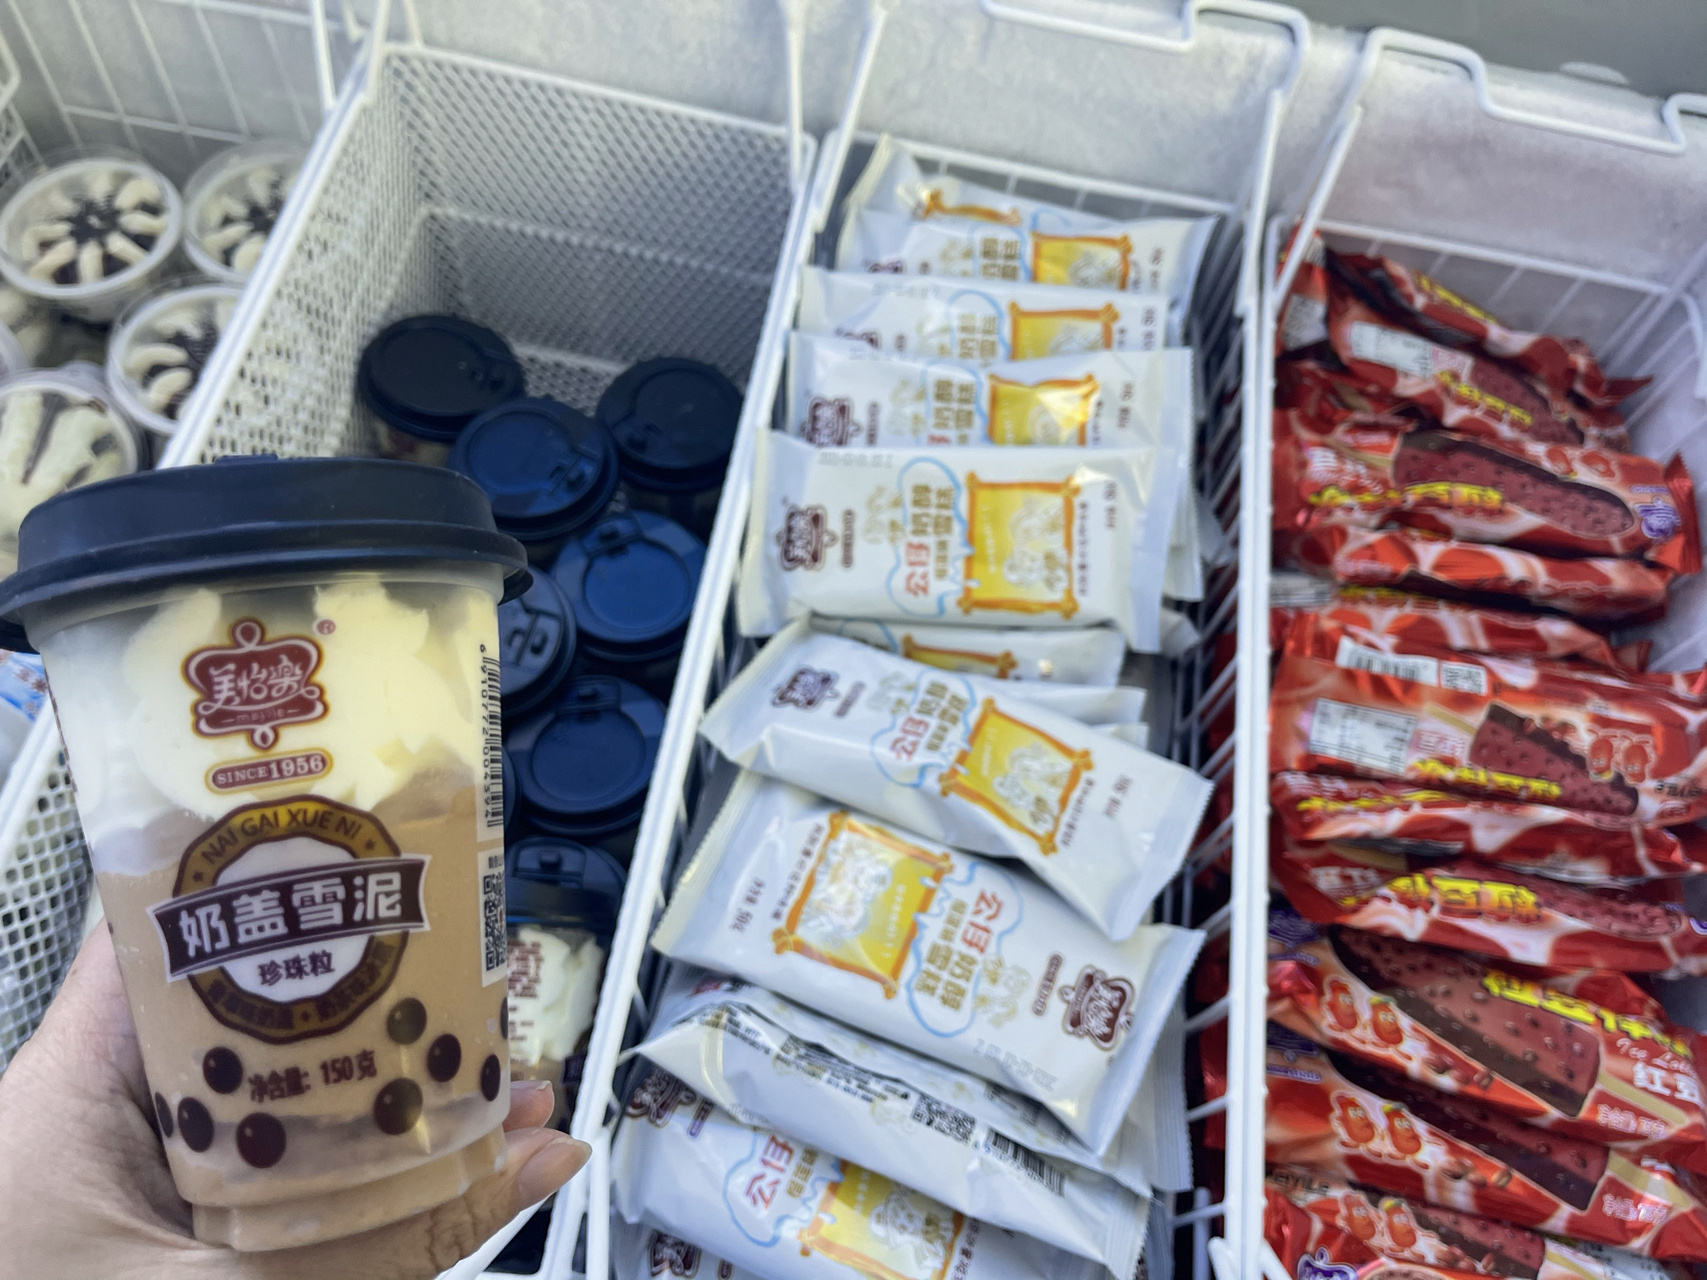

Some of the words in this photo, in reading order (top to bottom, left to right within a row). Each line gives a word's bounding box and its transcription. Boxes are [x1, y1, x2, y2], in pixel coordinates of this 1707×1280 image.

[201, 826, 239, 865] NAI
[241, 811, 279, 837] GAI
[287, 808, 333, 830] XUE
[335, 815, 362, 840] NI
[178, 871, 401, 958] 奶盖雪泥
[257, 949, 335, 986] 珍珠粒
[320, 1050, 378, 1085] 150克
[745, 1134, 795, 1210] 公仔
